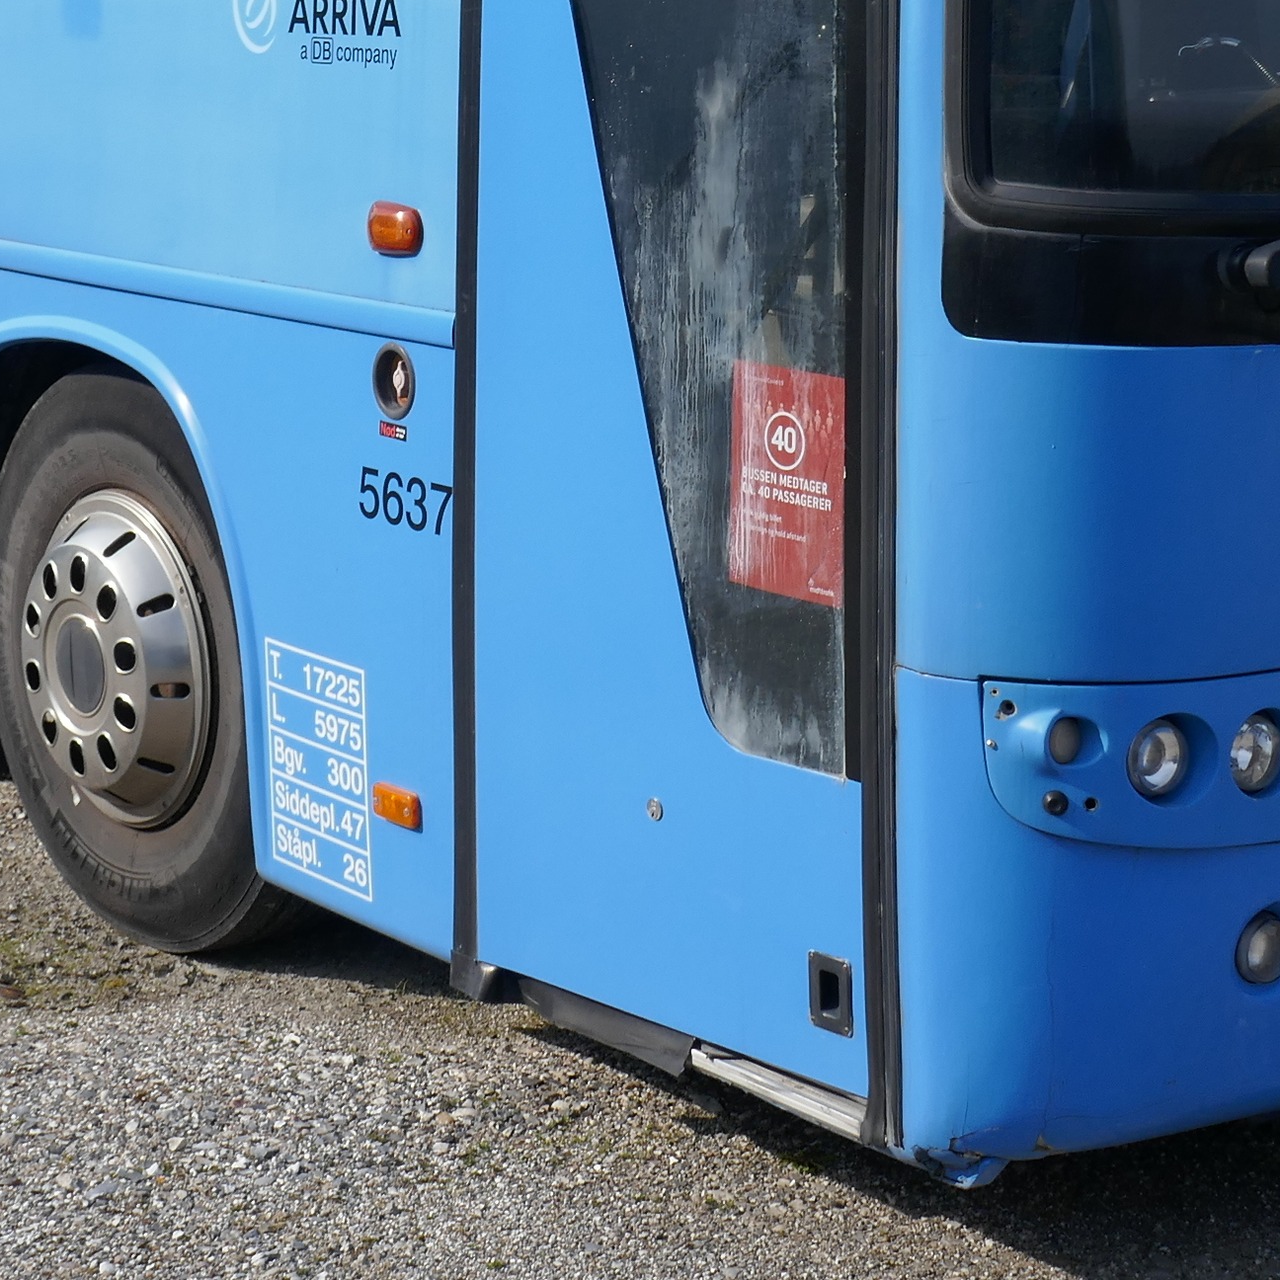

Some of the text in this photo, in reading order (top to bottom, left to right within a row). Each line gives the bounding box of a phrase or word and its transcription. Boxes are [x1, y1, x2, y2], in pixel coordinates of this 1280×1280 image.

[300, 39, 397, 69] a DB company
[771, 425, 796, 454] 40
[359, 466, 453, 535] 5637
[742, 466, 827, 495] BUSSEN MEDTAGER
[758, 485, 770, 499] 40
[772, 488, 832, 512] PASSAGERER
[270, 649, 361, 708] T. 17225
[272, 693, 362, 751] L. 5975
[274, 735, 363, 795] Bgv. 300
[275, 780, 365, 841] Siddepl. 47
[276, 822, 368, 887] Ståpl. 26
